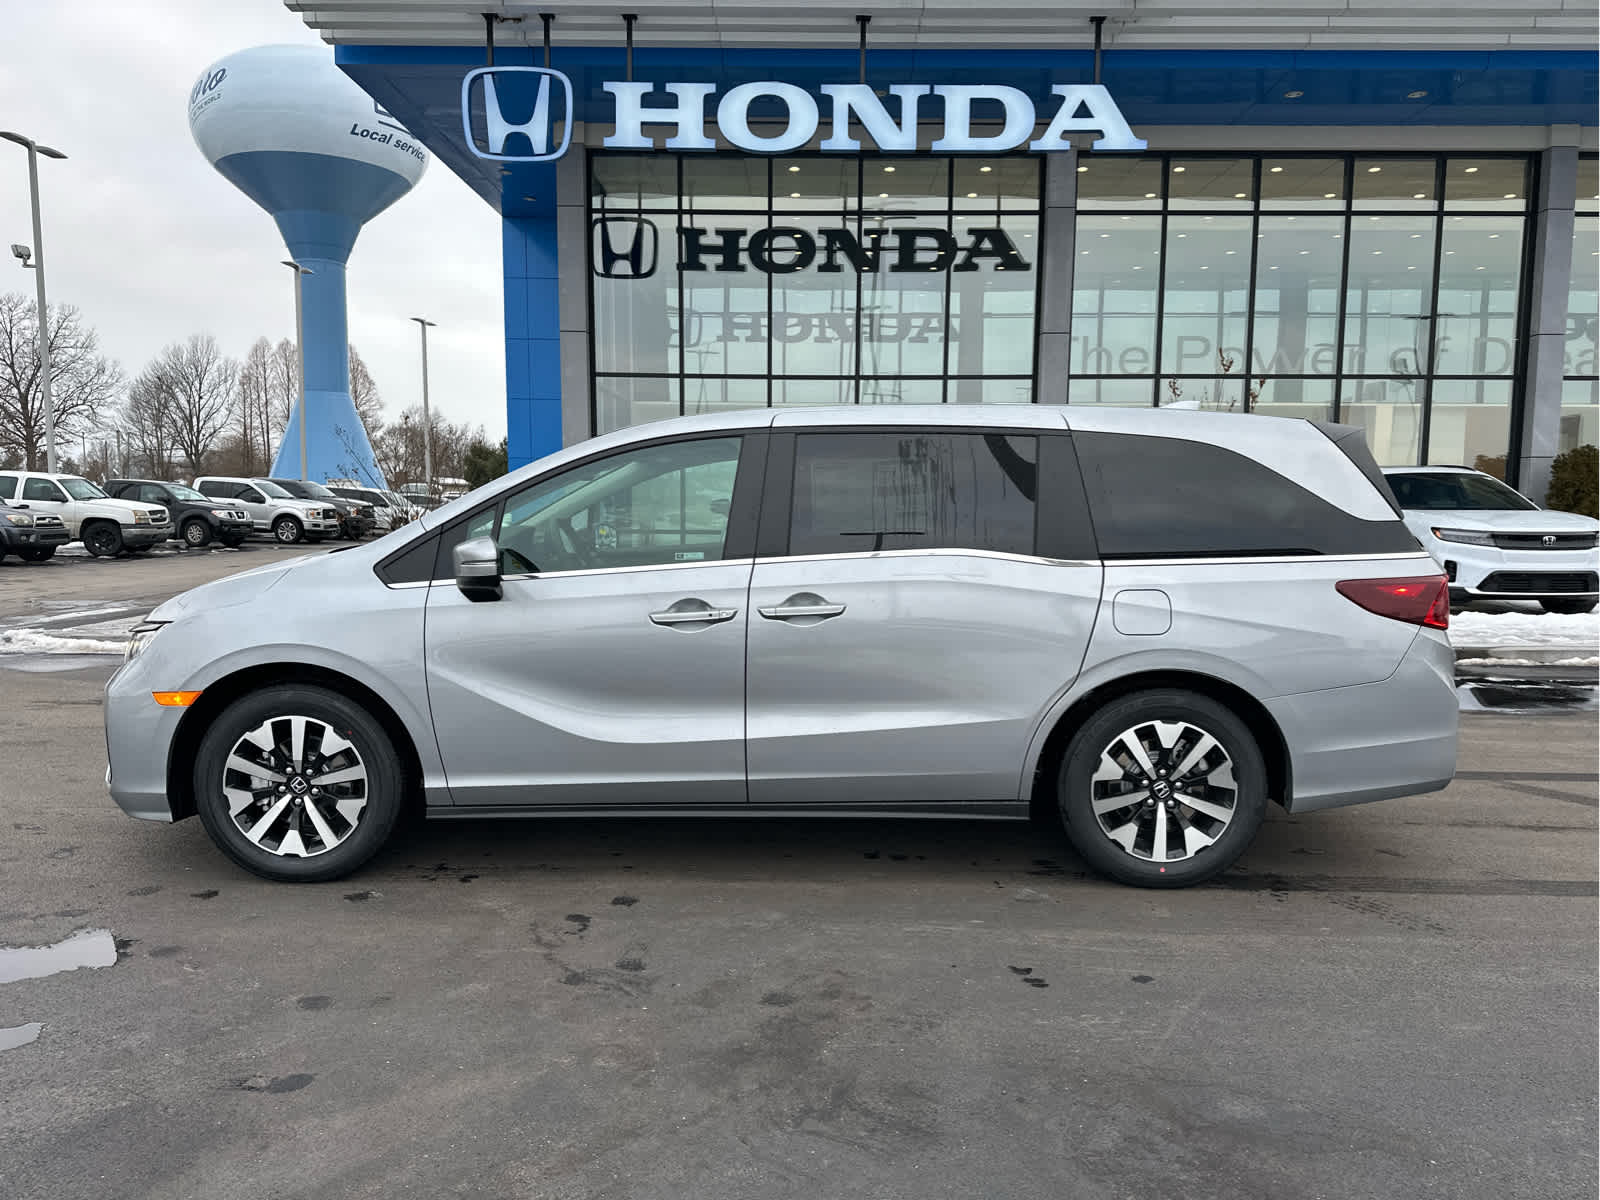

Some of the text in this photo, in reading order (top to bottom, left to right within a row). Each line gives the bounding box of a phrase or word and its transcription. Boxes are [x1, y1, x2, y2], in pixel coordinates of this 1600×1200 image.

[350, 123, 394, 145] Local
[602, 81, 1148, 153] HONDA
[676, 226, 1032, 274] HONDA
[716, 311, 960, 344] HONDA
[1176, 335, 1367, 375] Power
[1389, 336, 1452, 375] of
